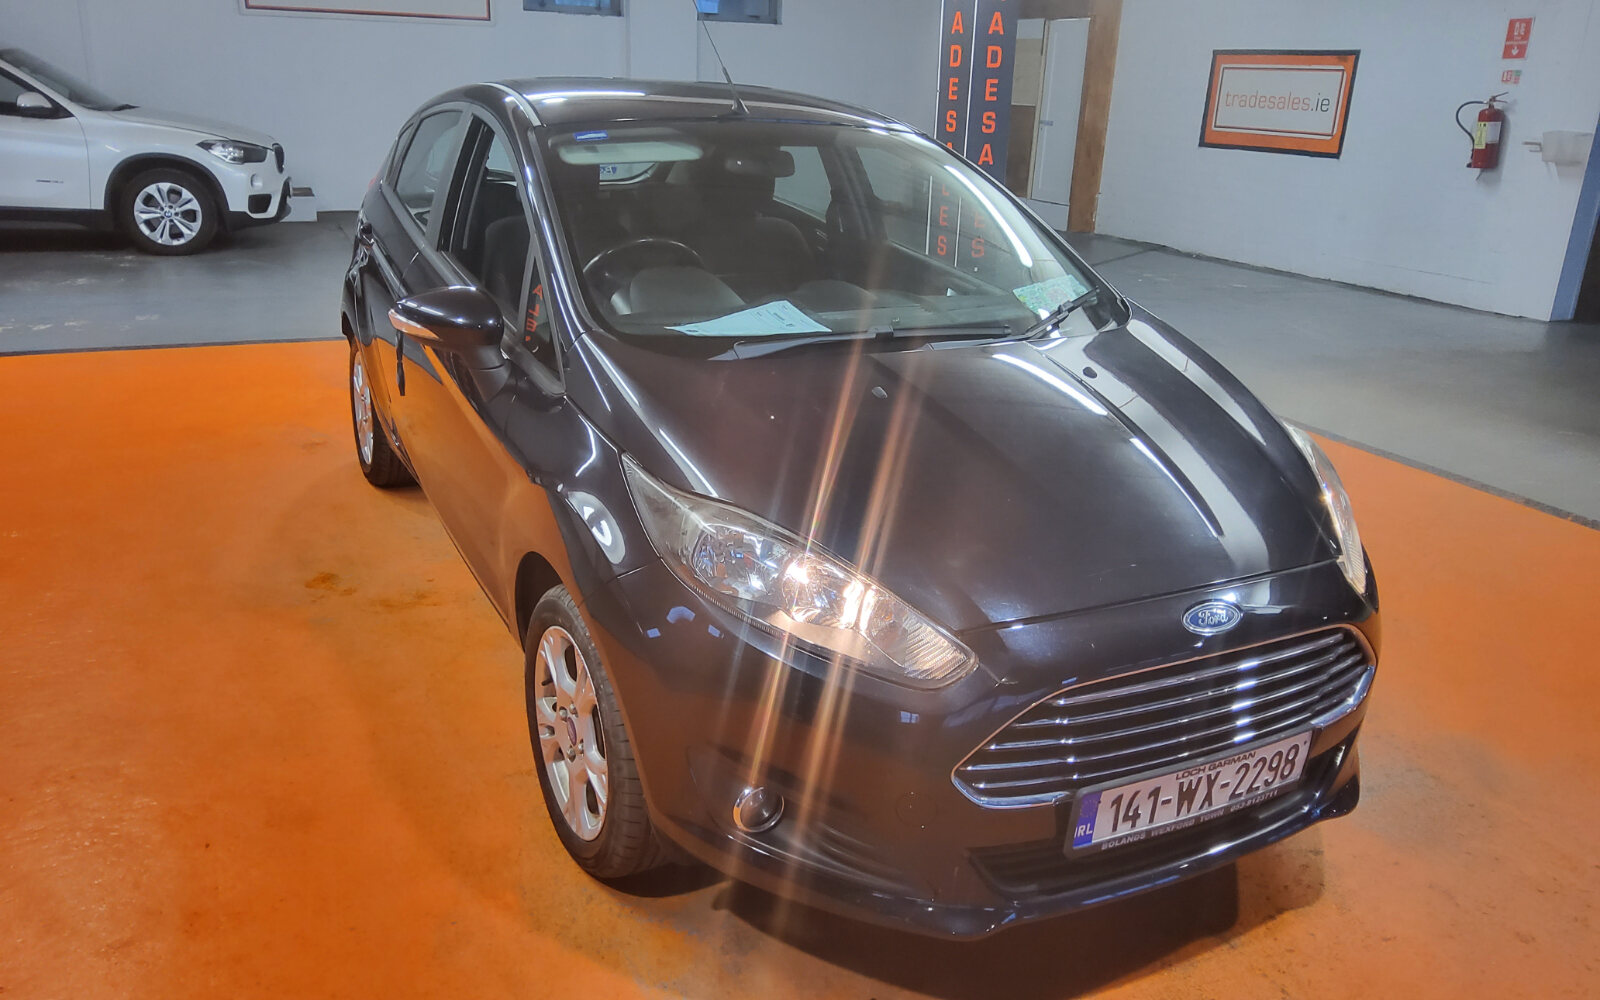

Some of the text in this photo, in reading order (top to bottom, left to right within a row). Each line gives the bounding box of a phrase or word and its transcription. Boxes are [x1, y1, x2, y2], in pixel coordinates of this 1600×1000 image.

[1225, 90, 1330, 113] tradesales.ie
[1198, 608, 1228, 625] Ford
[1175, 751, 1257, 780] LOCH GARMAN
[1110, 743, 1299, 833] 141-WX-2298
[1074, 822, 1093, 840] IRL
[1101, 832, 1146, 850] BOLANDS
[1151, 819, 1195, 837] WEXFORD
